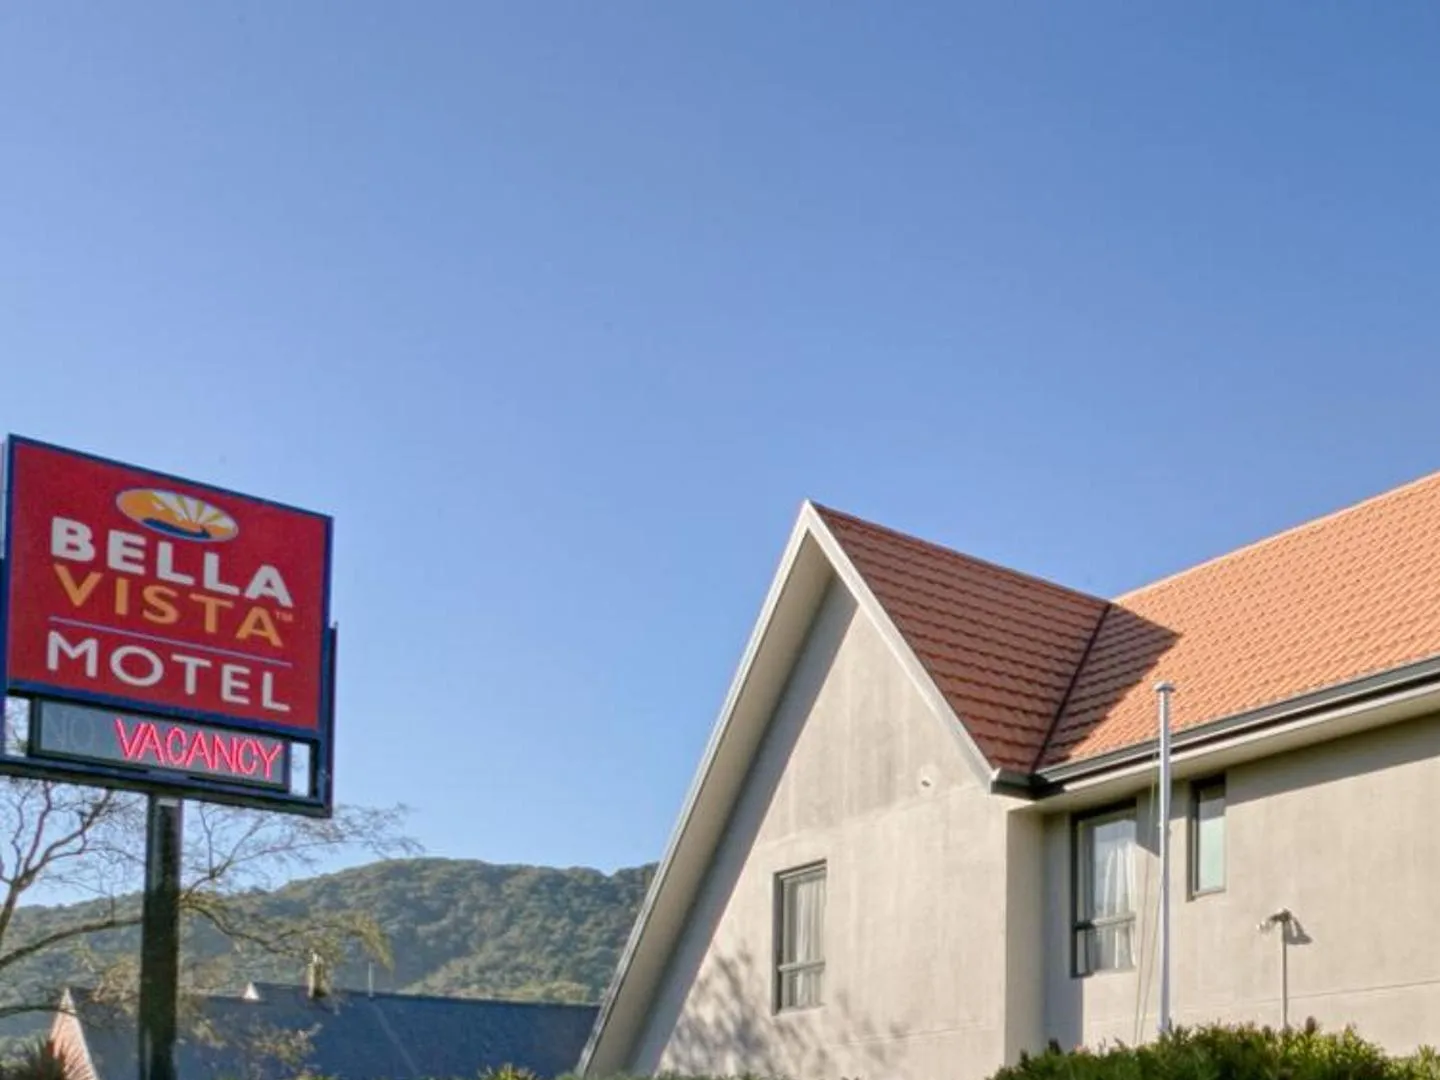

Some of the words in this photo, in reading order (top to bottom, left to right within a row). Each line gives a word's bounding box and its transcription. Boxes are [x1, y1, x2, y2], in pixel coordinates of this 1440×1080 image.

[51, 515, 293, 608] BELLA
[53, 563, 284, 648] VISTA
[46, 630, 291, 713] MOTEL
[115, 717, 284, 779] VACANCY
